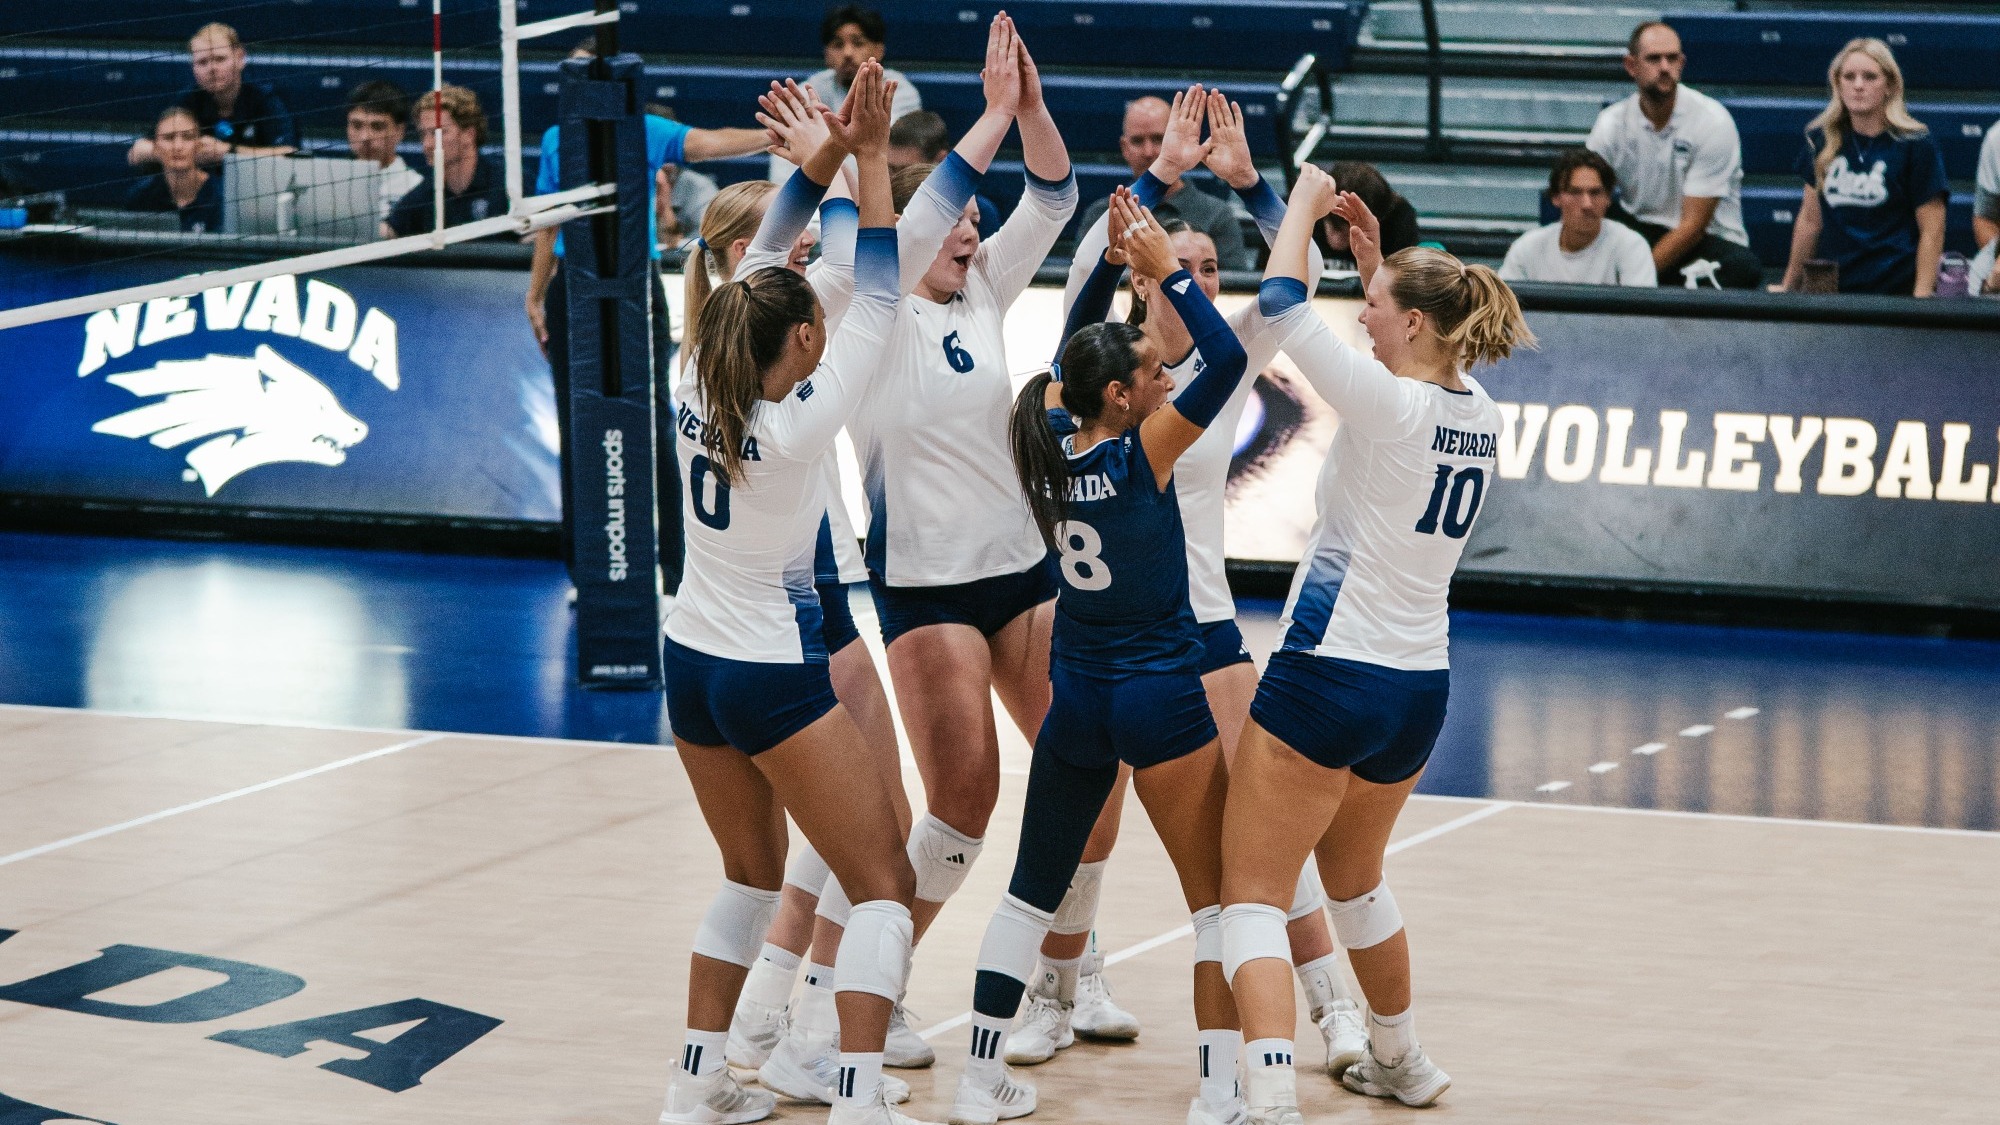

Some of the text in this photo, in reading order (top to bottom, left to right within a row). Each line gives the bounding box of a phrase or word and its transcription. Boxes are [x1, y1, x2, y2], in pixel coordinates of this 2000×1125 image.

[78, 270, 399, 391] NEVADA
[942, 329, 975, 374] 6
[1431, 424, 1497, 459] NEVADA
[1495, 402, 2000, 505] VOLLEYBAL
[601, 429, 630, 582] sports imports
[690, 453, 732, 532] 0
[1414, 463, 1485, 540] 10
[1054, 519, 1112, 592] 8
[0, 927, 506, 1094] DA
